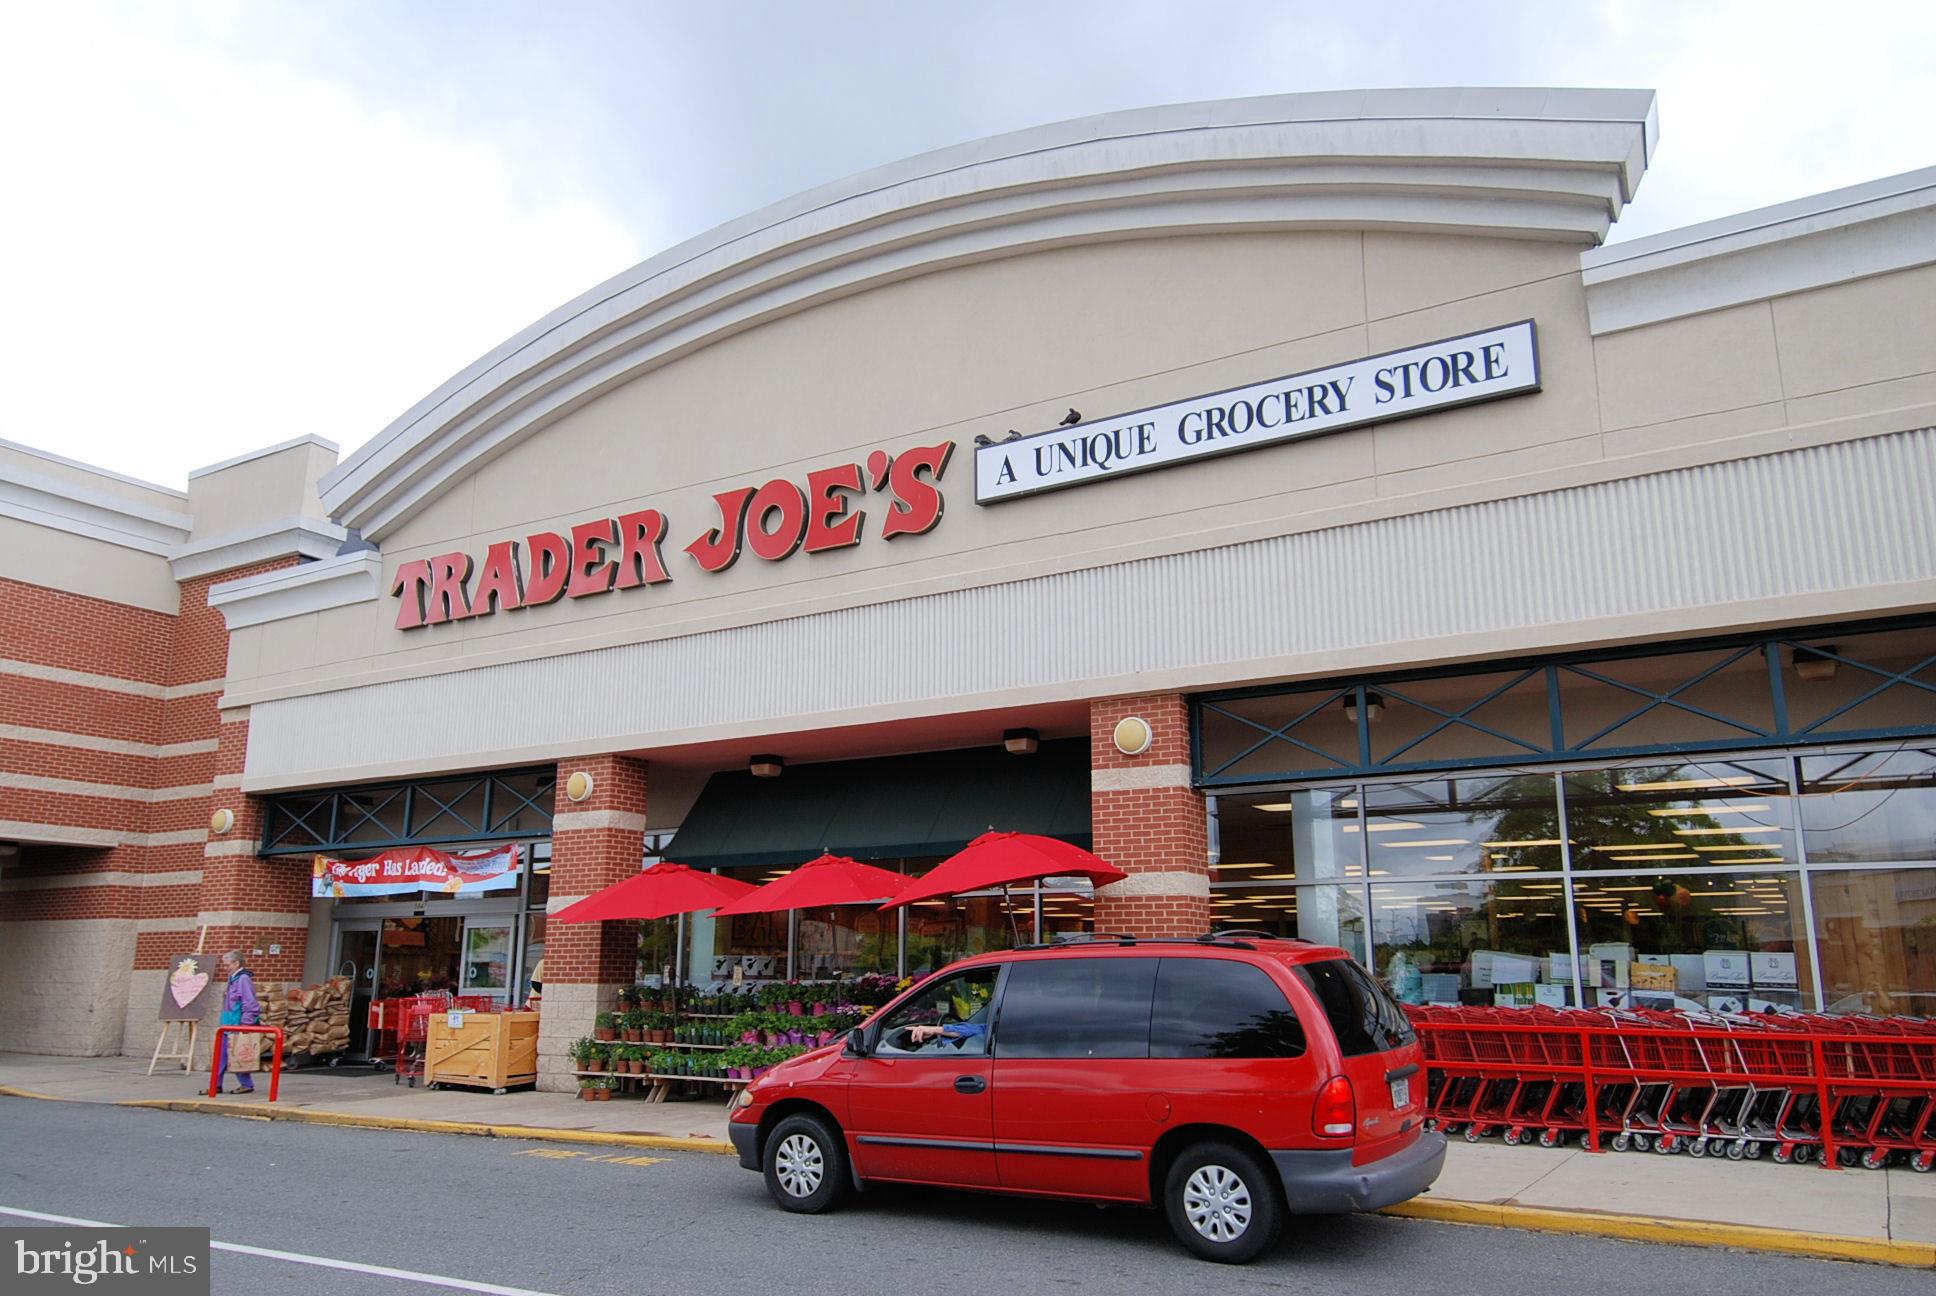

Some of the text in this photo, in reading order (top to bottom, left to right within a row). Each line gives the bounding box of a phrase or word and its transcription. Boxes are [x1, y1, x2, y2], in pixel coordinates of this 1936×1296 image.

[995, 342, 1509, 486] A UNIQUE GROCERY STORE
[389, 440, 957, 630] TRADER JOE'S
[383, 859, 402, 876] Has
